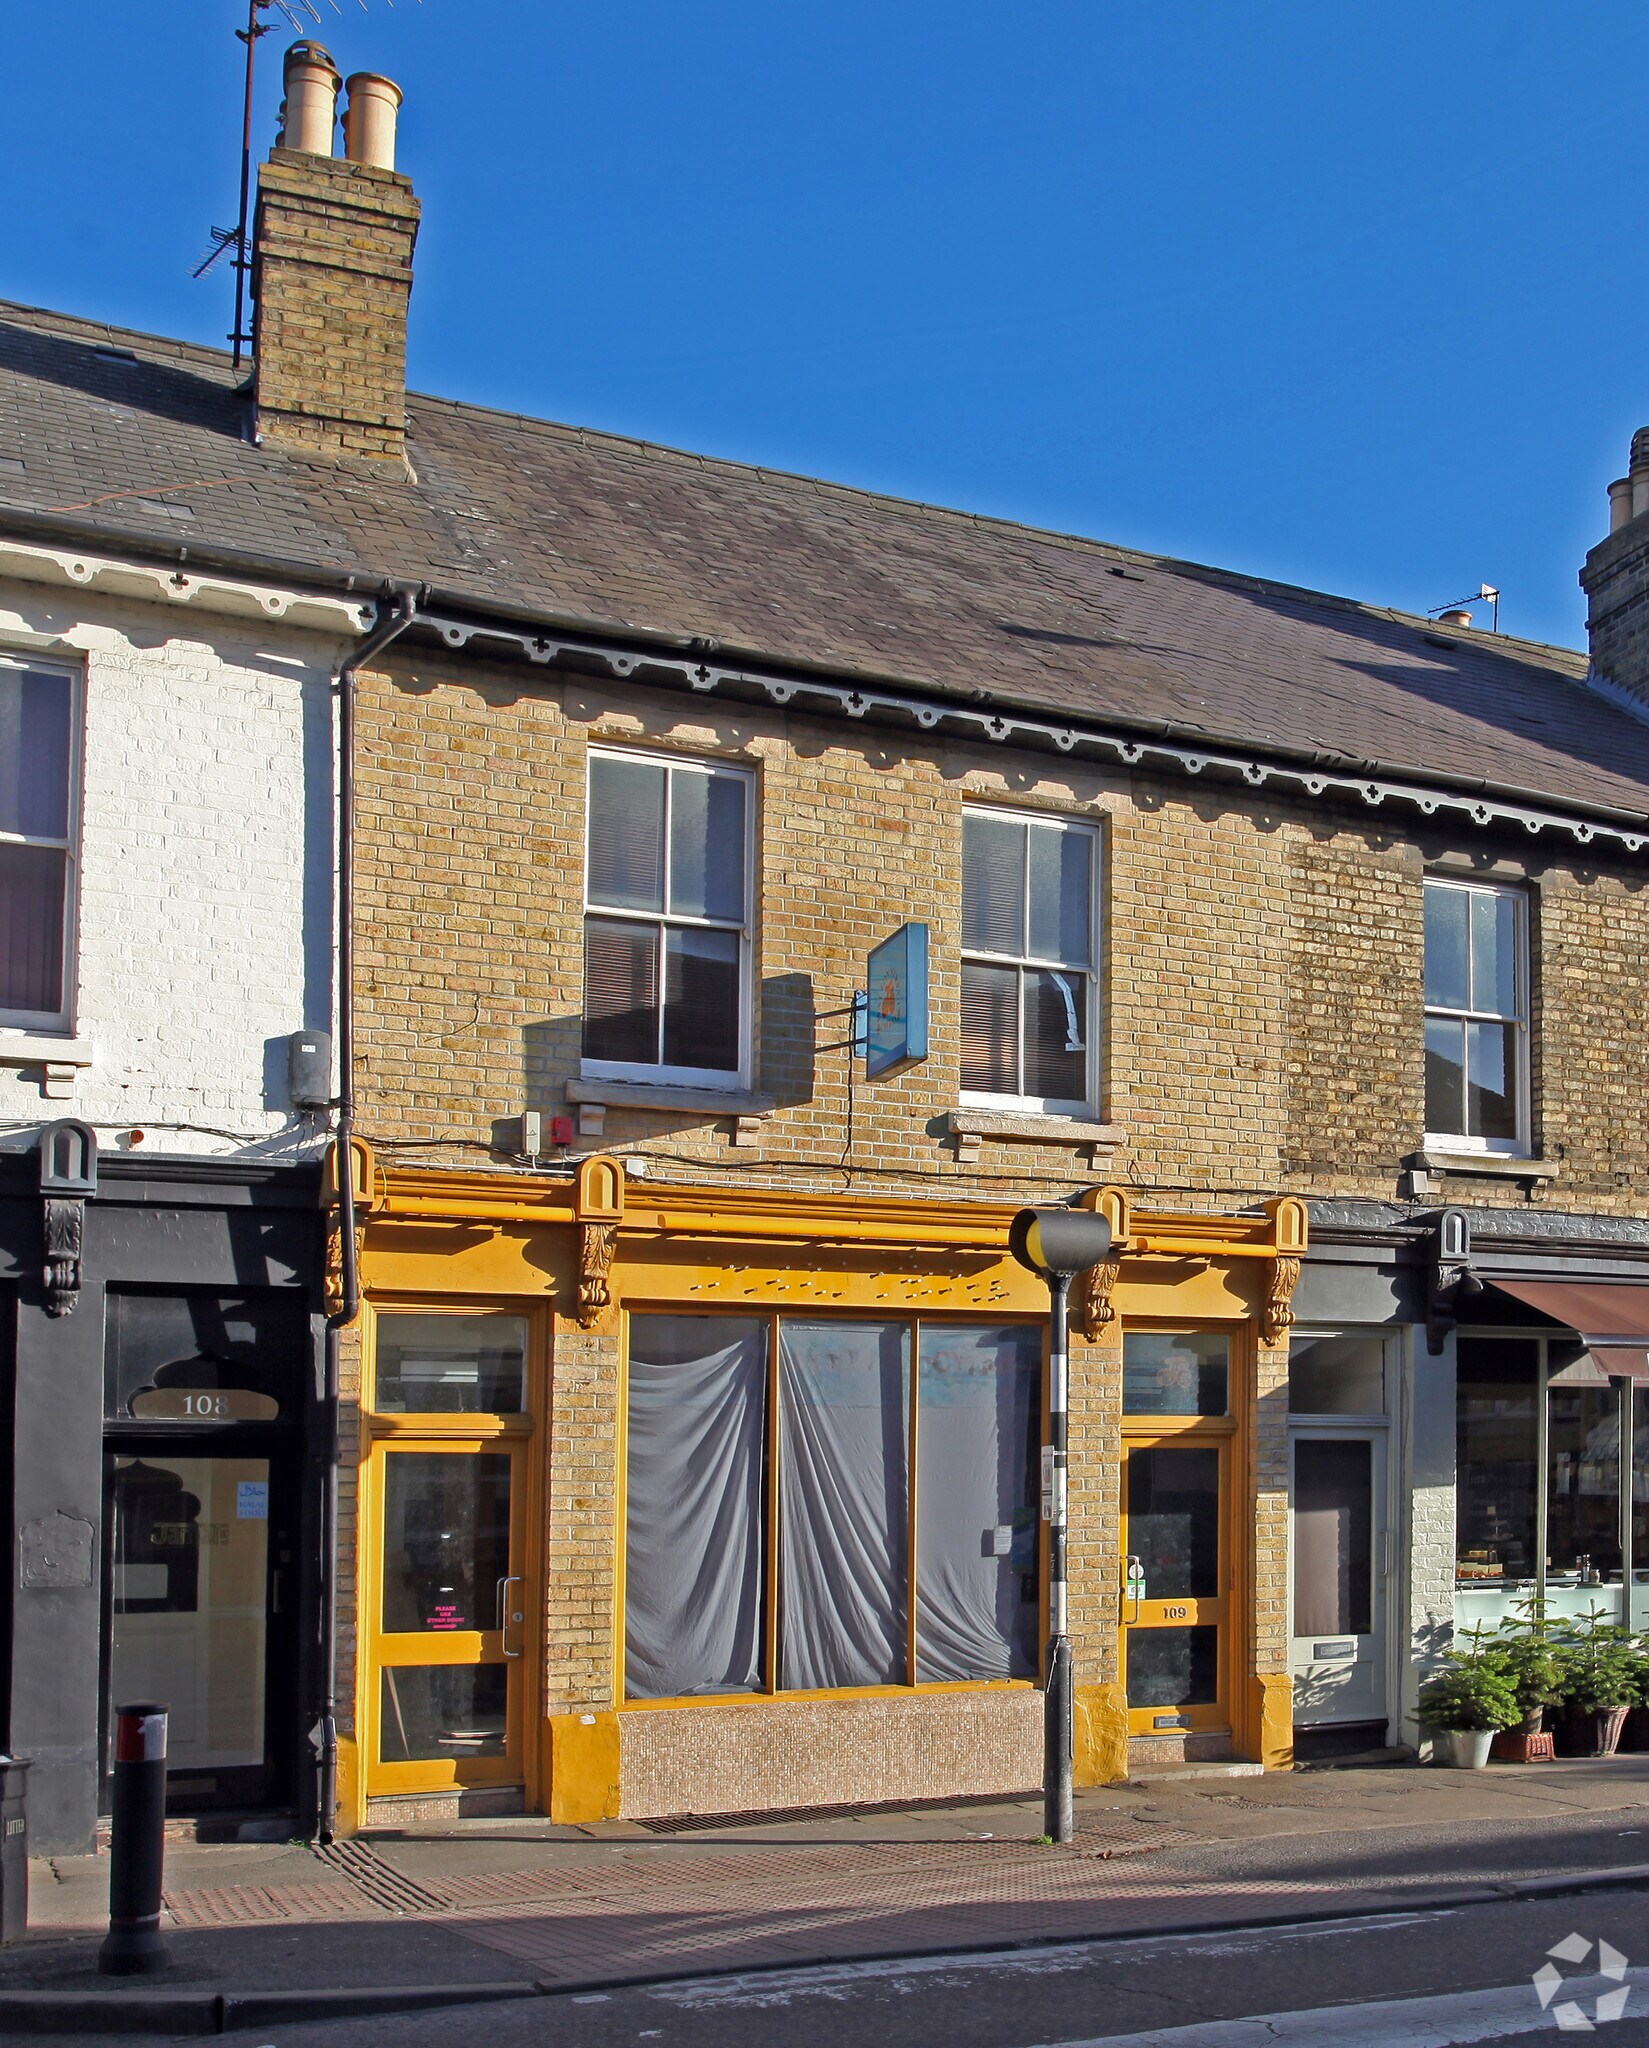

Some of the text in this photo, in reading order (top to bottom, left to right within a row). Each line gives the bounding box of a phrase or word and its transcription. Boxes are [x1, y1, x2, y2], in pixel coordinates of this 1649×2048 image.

[183, 1395, 229, 1415] 108
[1163, 1606, 1187, 1619] 109
[6, 1818, 25, 1836] LITTER
